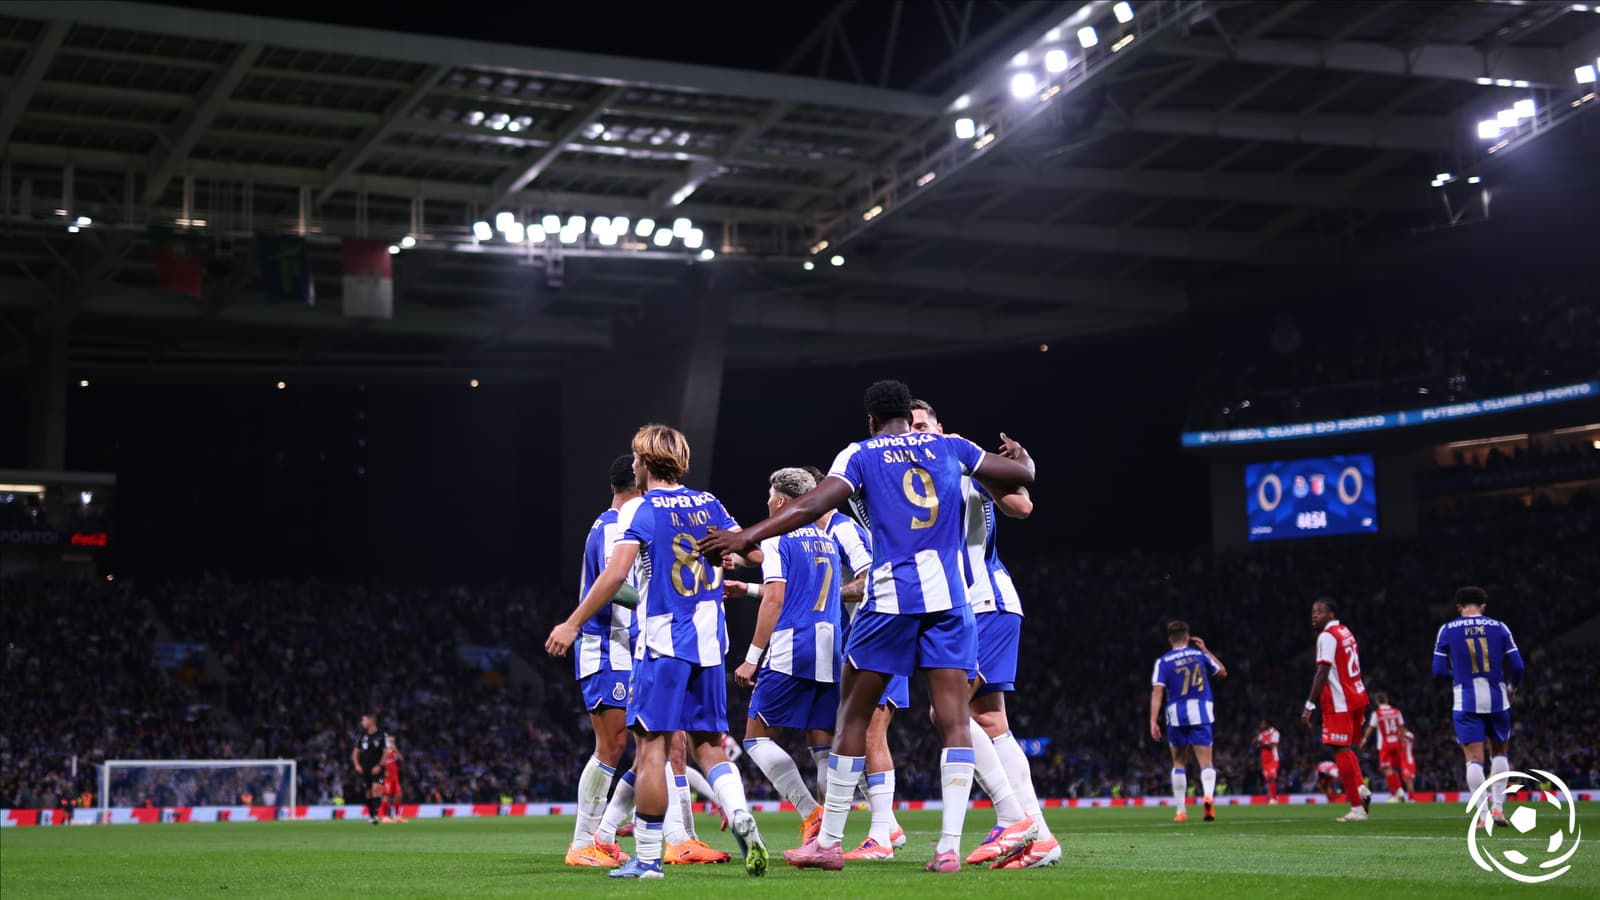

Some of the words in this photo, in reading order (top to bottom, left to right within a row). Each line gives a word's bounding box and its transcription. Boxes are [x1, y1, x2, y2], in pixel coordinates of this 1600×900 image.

[1526, 391, 1544, 403] DO
[1547, 383, 1590, 400] PORTO
[1339, 415, 1386, 429] PORTO
[903, 467, 939, 530] 9
[1258, 473, 1282, 512] 0
[1338, 466, 1362, 505] 0
[651, 495, 693, 508] SUPER
[671, 511, 684, 526] R.
[801, 540, 813, 553] W.
[813, 556, 834, 612] 7
[1448, 619, 1474, 628] SUPER
[1475, 618, 1500, 626] BOCK
[1465, 637, 1491, 674] 11
[1174, 664, 1204, 696] 74
